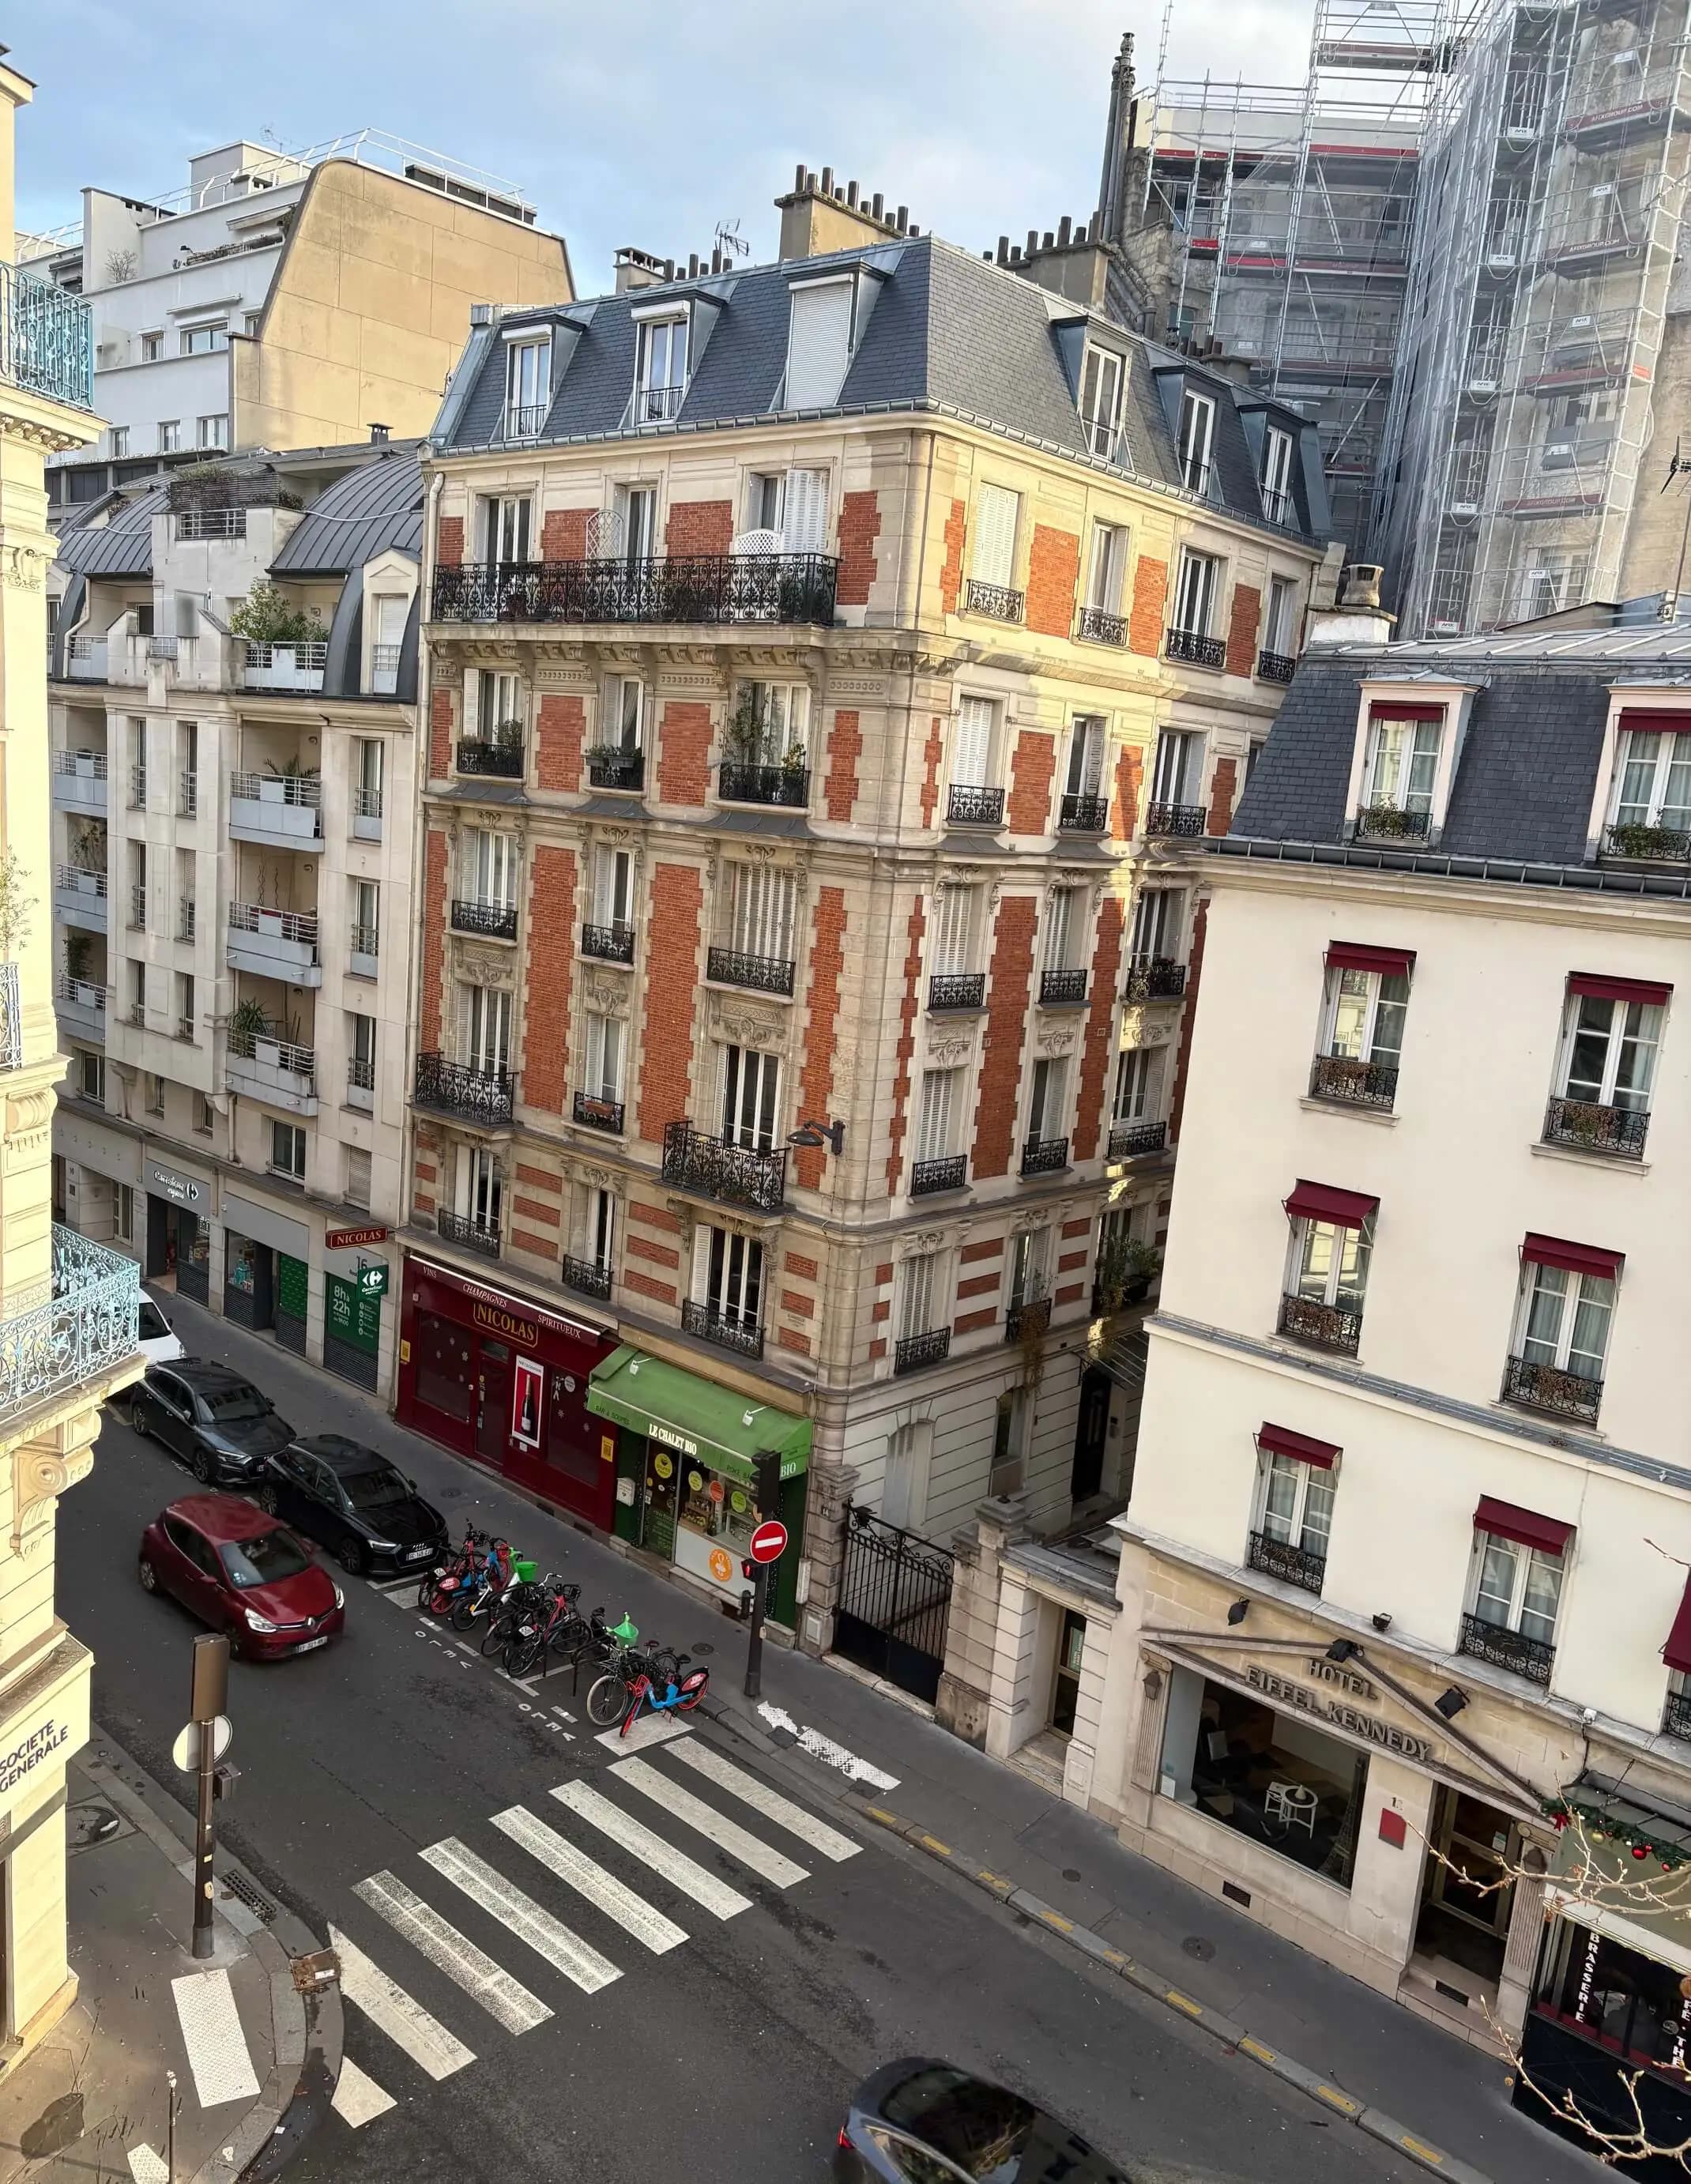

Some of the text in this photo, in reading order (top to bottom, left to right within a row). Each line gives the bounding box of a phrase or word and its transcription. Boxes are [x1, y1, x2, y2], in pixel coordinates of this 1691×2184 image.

[337, 1229, 382, 1246] NICOLAS
[423, 1266, 438, 1278] VINS
[332, 1298, 351, 1317] 22h
[462, 1282, 508, 1309] CHAMPAGNES
[476, 1304, 535, 1342] NICOLAS
[537, 1313, 582, 1339] SPIRITUEUX
[648, 1423, 698, 1455] LE CHALET BIO
[781, 1462, 797, 1478] BIO
[1309, 1659, 1378, 1700] HOTEL
[1245, 1665, 1432, 1762] EIFFEL KENNEDY
[0, 1719, 54, 1777] SOCIETE
[0, 1725, 68, 1793] GENERALE
[1575, 1932, 1601, 2024] BRASSERIE
